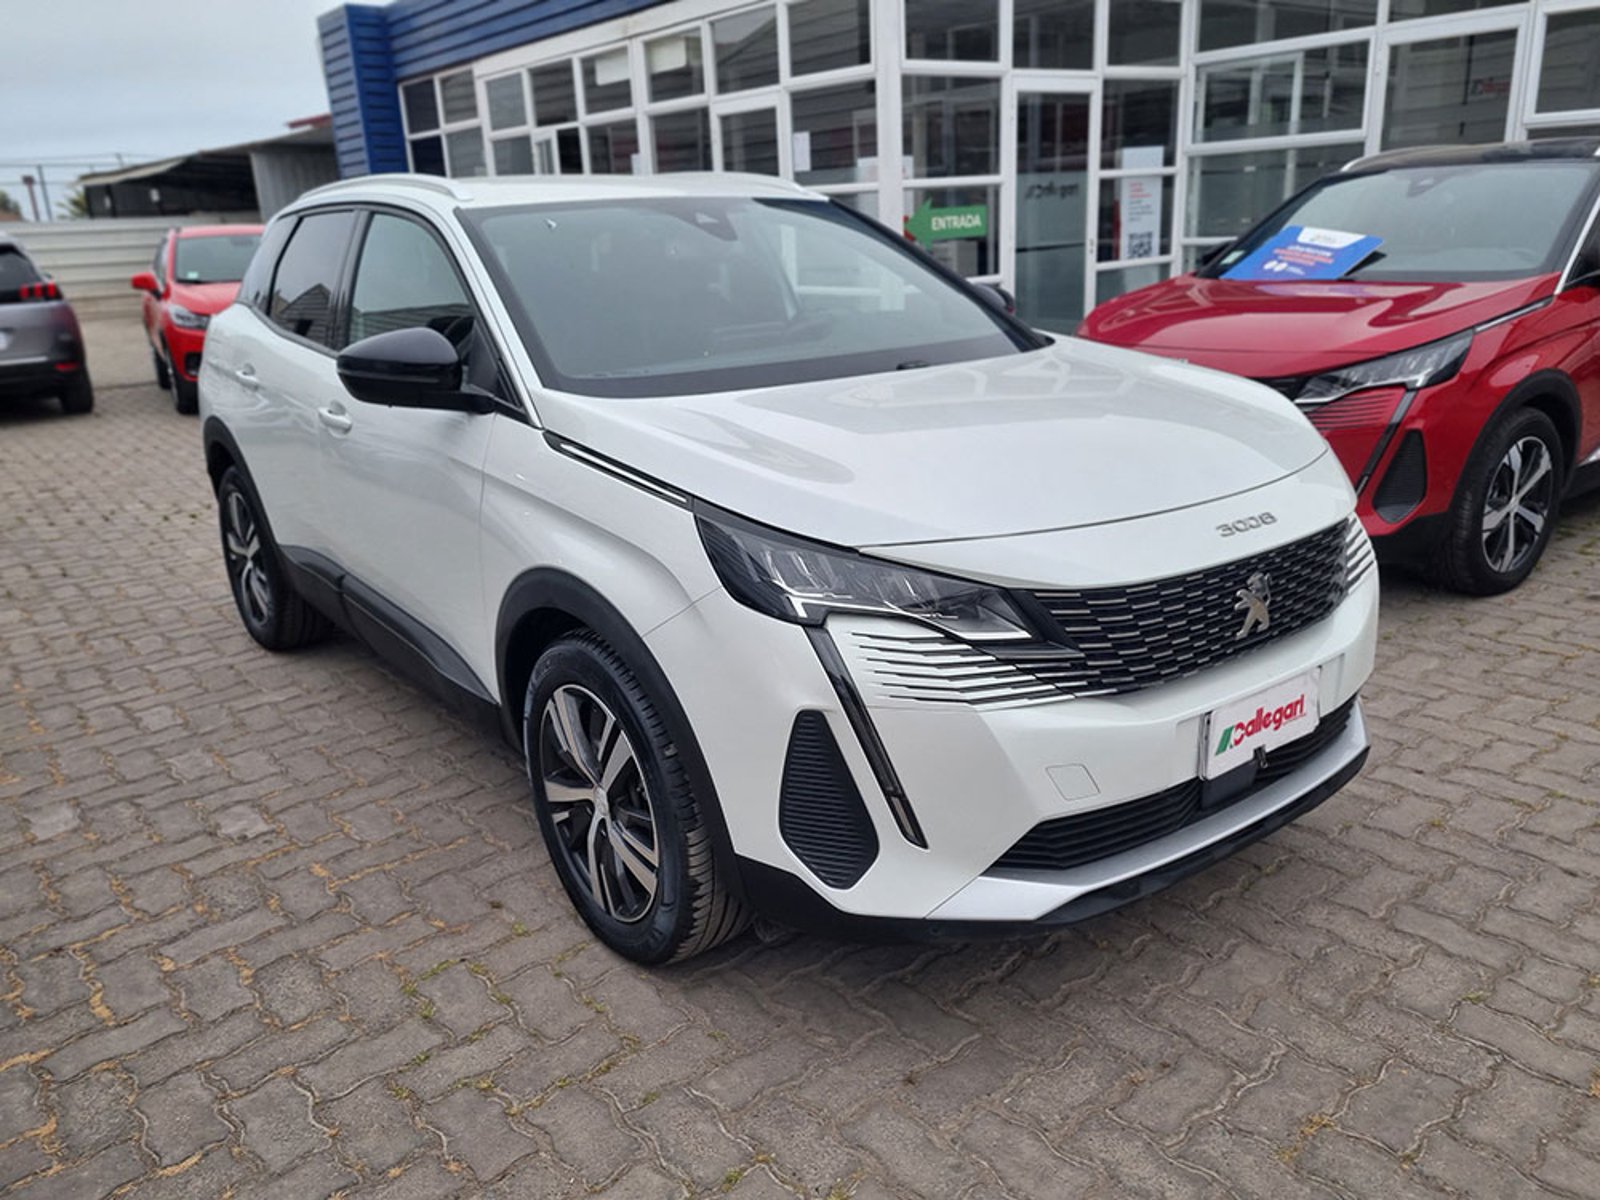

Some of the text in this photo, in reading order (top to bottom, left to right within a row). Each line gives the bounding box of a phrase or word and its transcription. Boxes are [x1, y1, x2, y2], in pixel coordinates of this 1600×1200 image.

[931, 212, 982, 231] ENTRADA
[1216, 511, 1277, 537] 3008
[1232, 693, 1305, 746] Callegari
